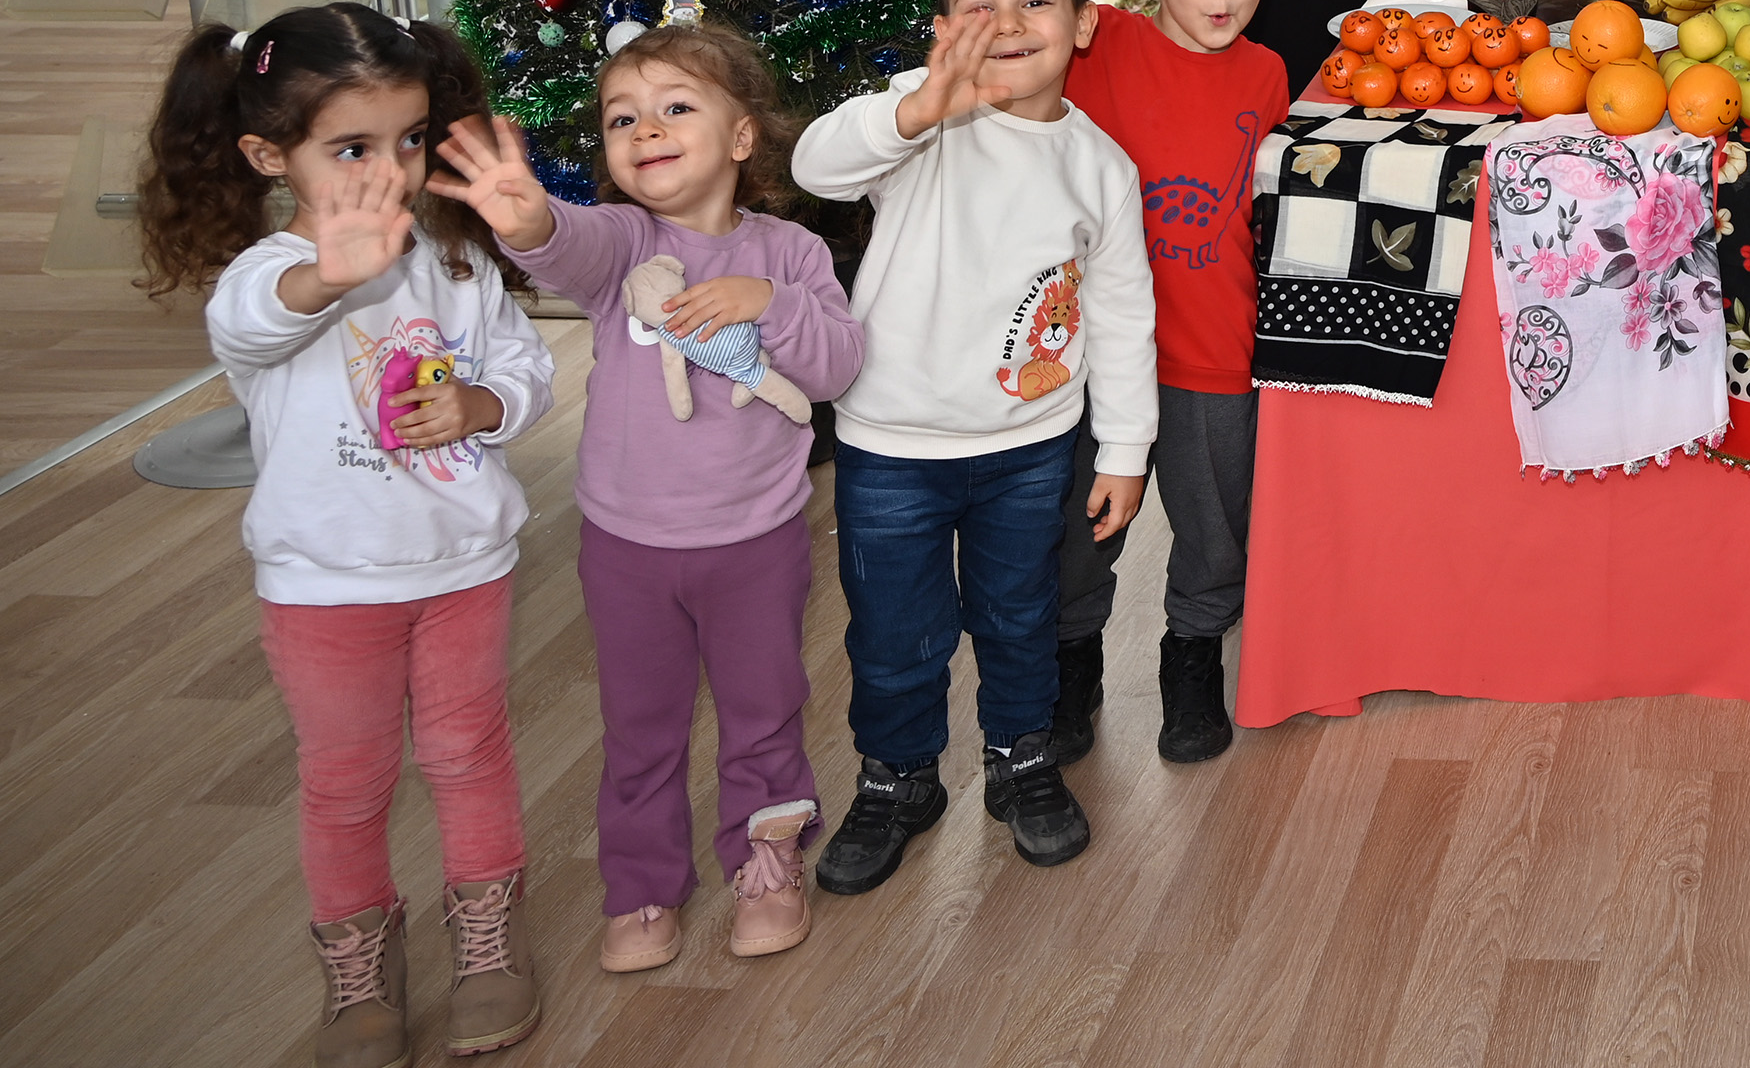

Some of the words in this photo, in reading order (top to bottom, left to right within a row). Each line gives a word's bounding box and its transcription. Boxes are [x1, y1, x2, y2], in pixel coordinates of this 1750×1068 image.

[1012, 285, 1040, 324] LITTLE
[1036, 267, 1058, 285] KING
[338, 449, 388, 473] Stars
[1012, 753, 1044, 773] Polaris
[864, 779, 896, 792] Polaris
